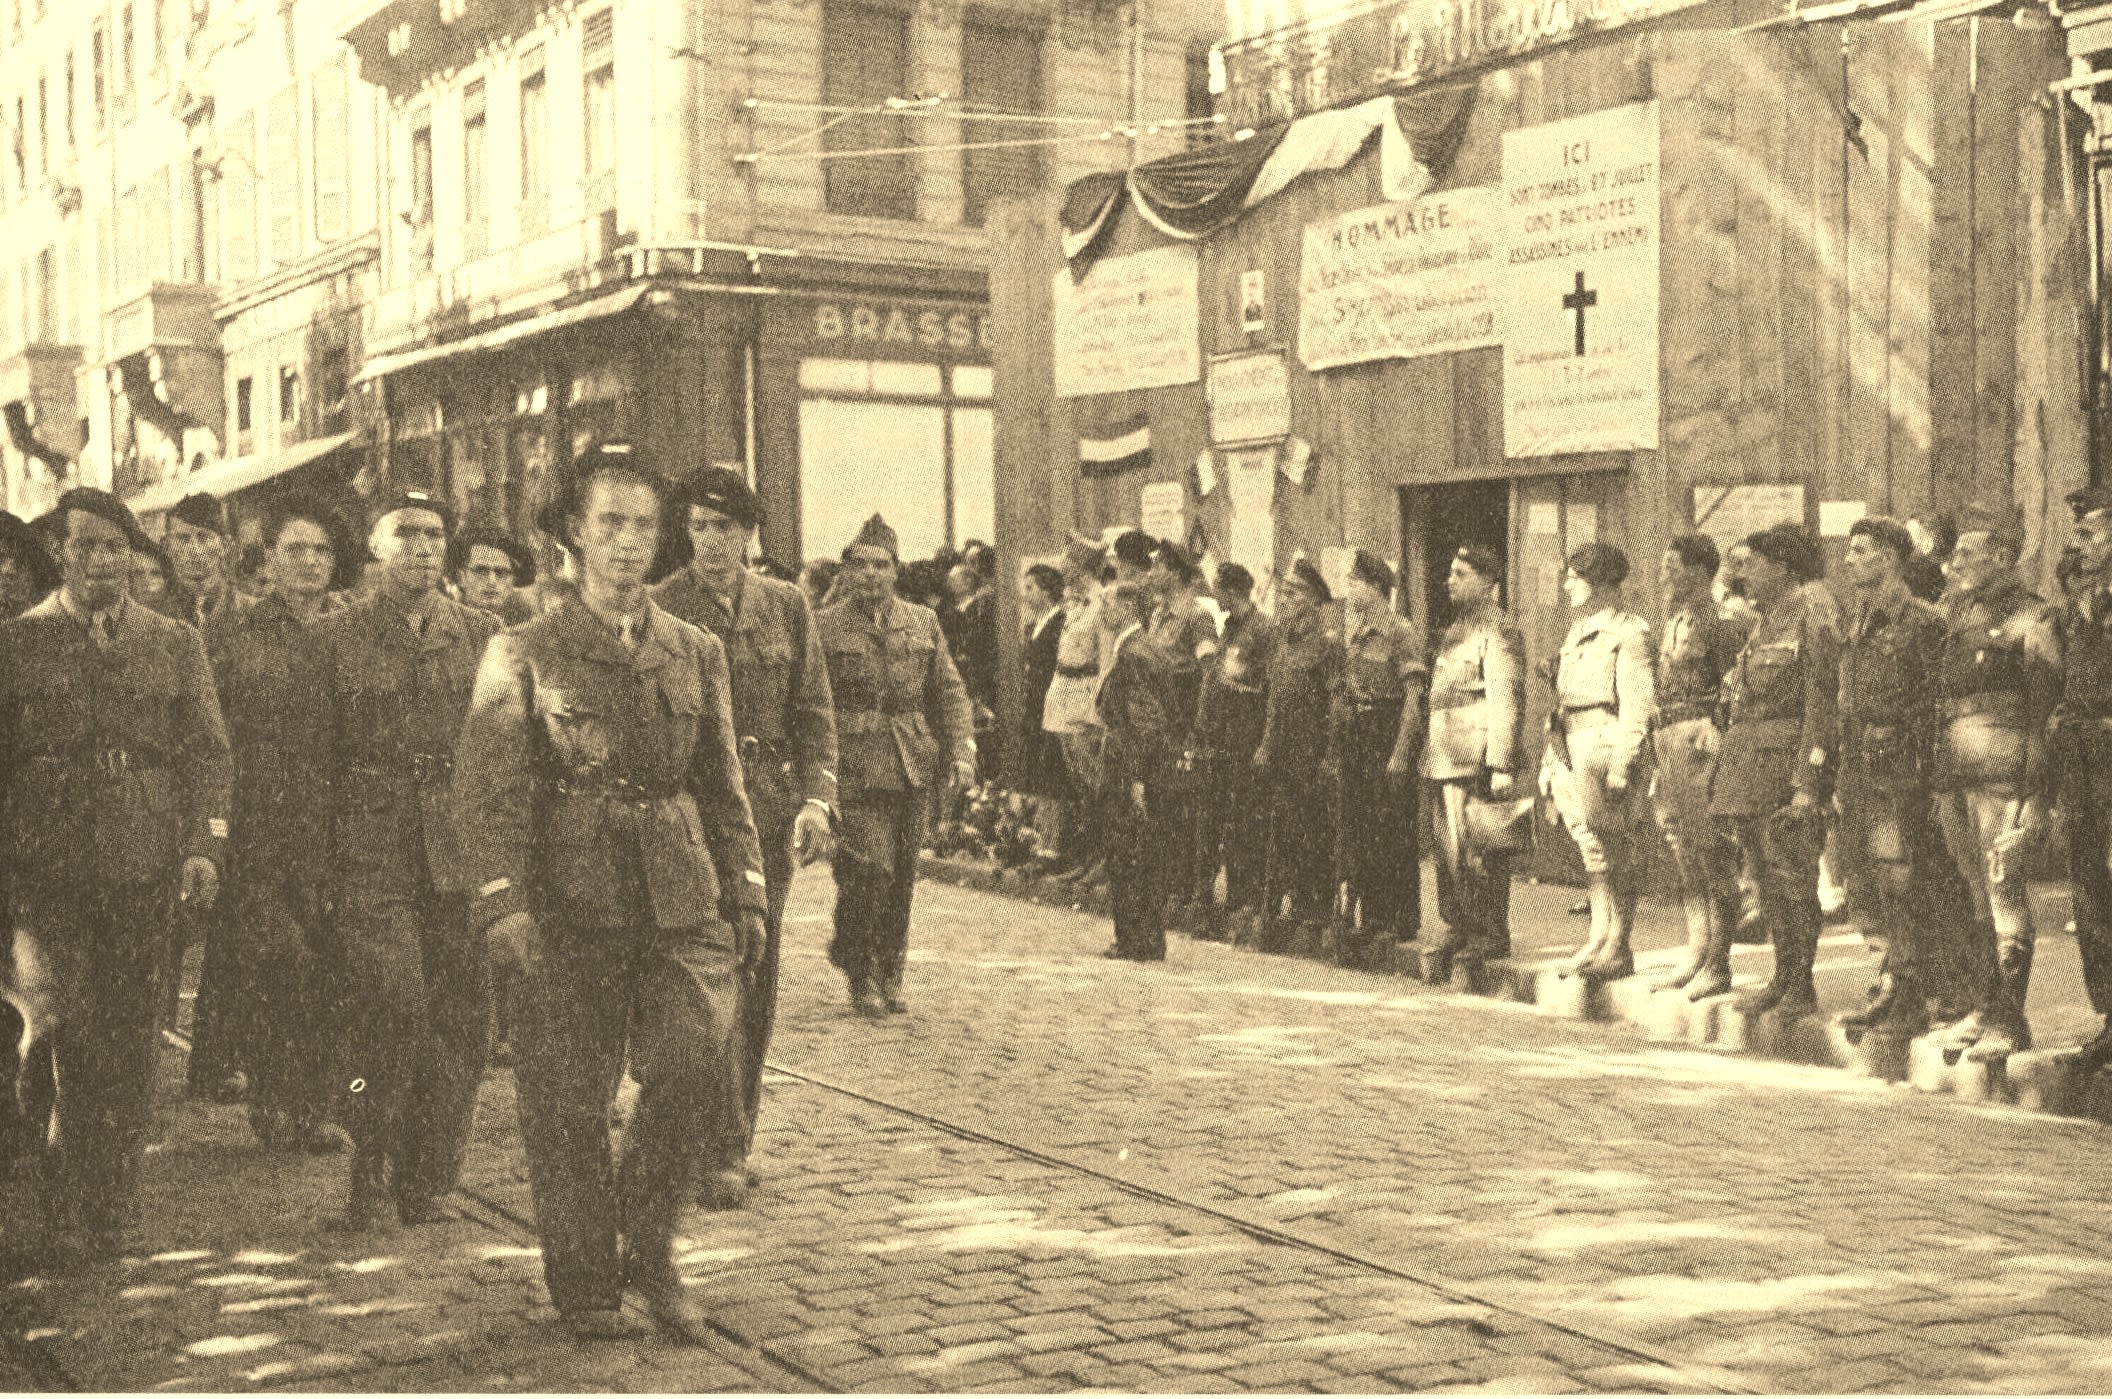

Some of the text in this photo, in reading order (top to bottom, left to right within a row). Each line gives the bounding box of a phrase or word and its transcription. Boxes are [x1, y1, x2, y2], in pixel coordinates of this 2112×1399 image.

[1563, 140, 1590, 166] ICI
[1611, 162, 1653, 188] JUILLET
[1559, 196, 1635, 227] PATRIOTES
[1331, 203, 1452, 251] HOMMAGE
